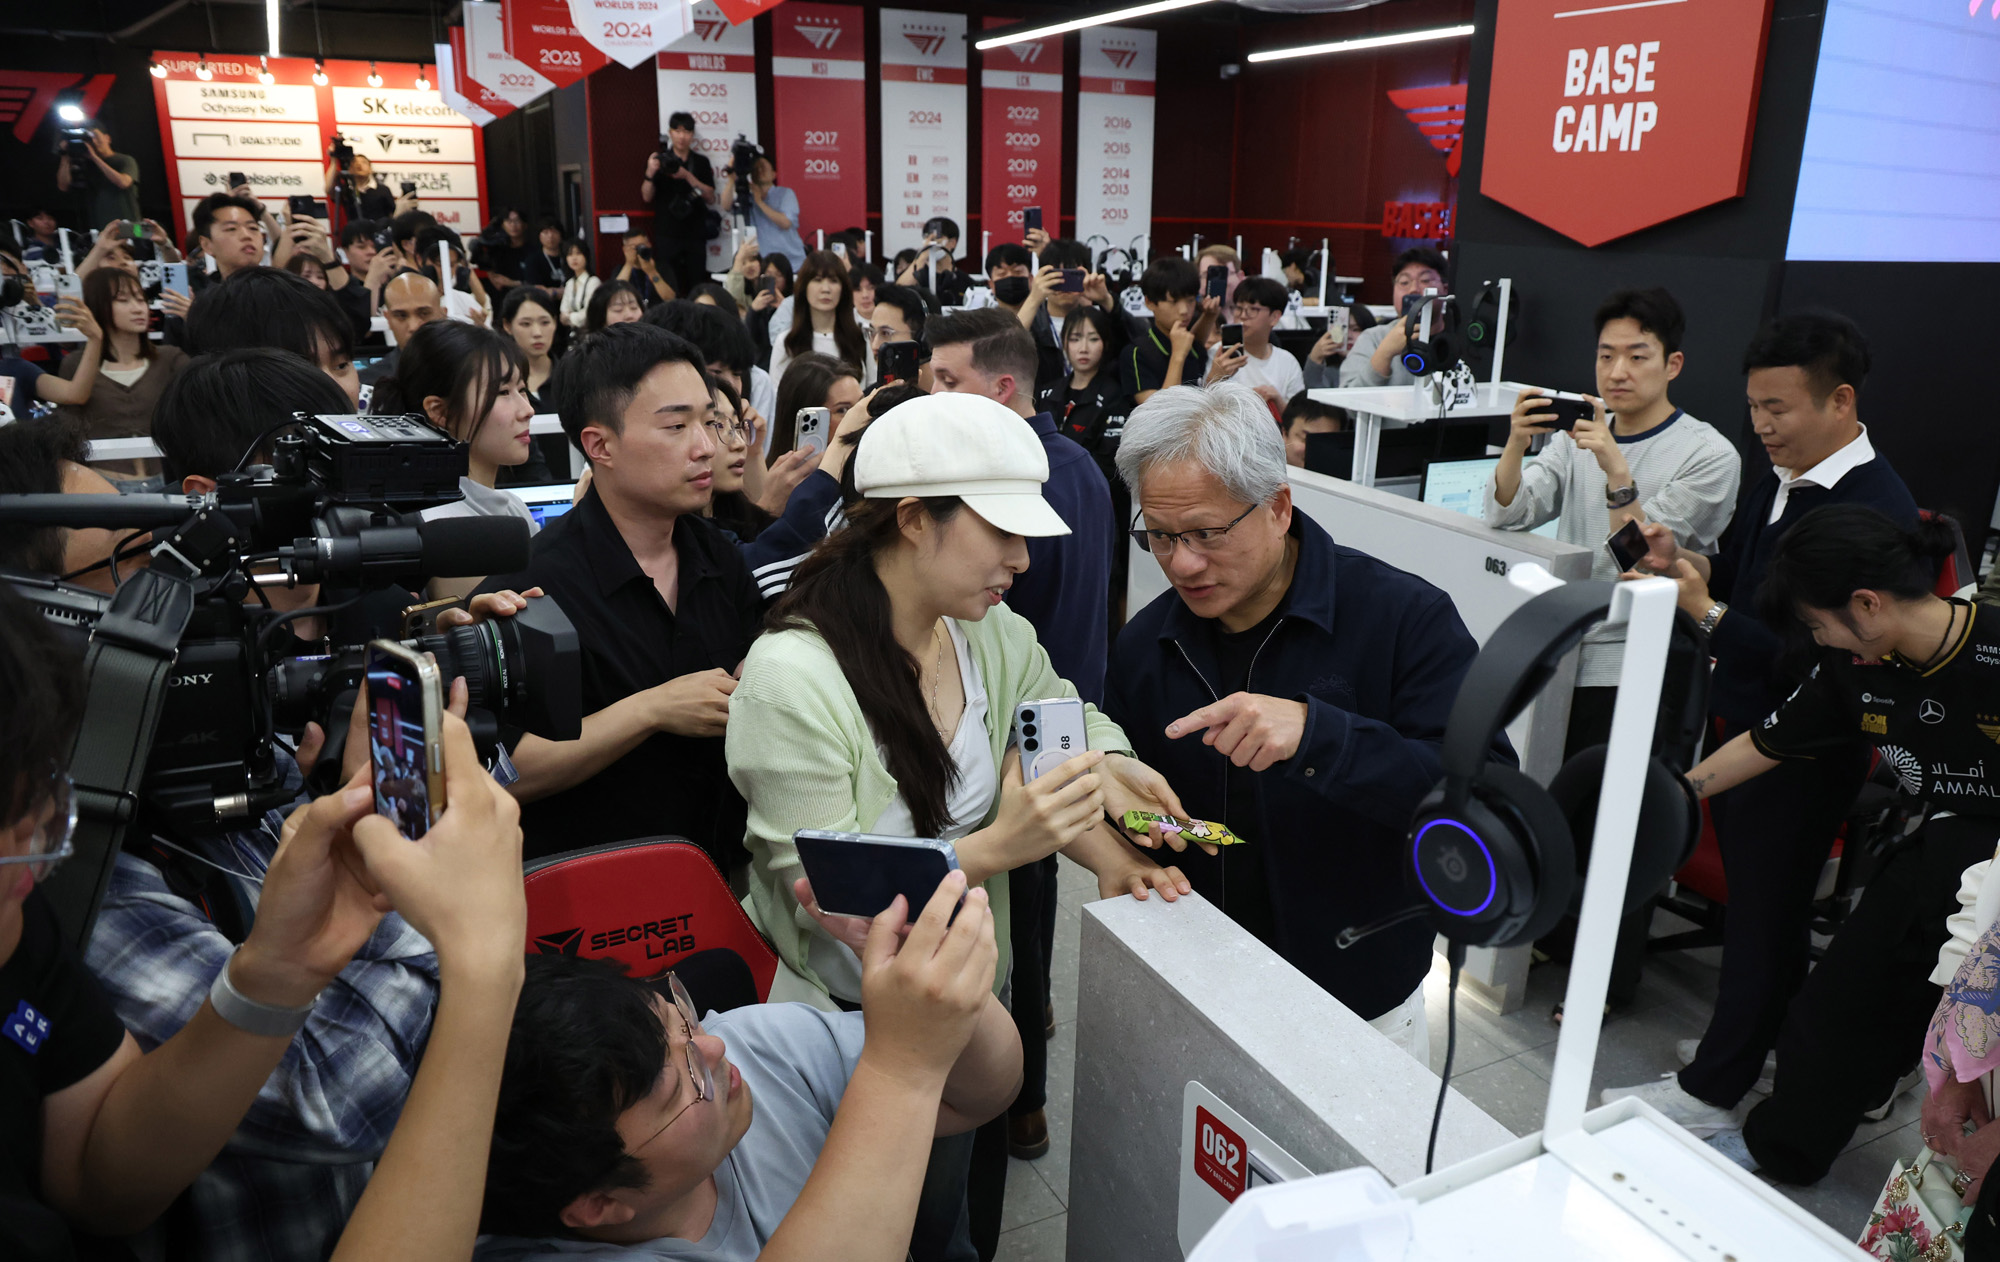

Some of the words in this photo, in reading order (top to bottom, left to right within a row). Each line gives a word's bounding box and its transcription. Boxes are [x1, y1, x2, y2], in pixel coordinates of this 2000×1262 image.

[532, 24, 567, 35] WORLDS
[603, 22, 652, 38] 2024
[539, 49, 582, 66] 2023
[688, 54, 726, 70] WORLDS
[812, 62, 828, 75] MSI
[1563, 40, 1660, 97] BASE
[499, 73, 535, 86] 2022
[201, 87, 266, 99] SAMSUNG
[689, 83, 727, 96] 2025
[1112, 81, 1126, 93] LCK
[202, 103, 256, 117] Odyssey
[260, 105, 285, 115] Neo
[363, 97, 389, 114] SK
[909, 111, 942, 123] 2024
[1007, 106, 1039, 120] 2022
[1104, 116, 1132, 129] 2016
[1552, 101, 1658, 153] CAMP
[240, 136, 302, 146] GOALSTUDIO
[804, 131, 838, 145] 2017
[1005, 132, 1040, 147] 2020
[420, 145, 440, 154] LAB
[1103, 142, 1131, 155] 2015
[804, 160, 839, 174] 2016
[1007, 158, 1037, 172] 2019
[394, 171, 449, 182] TURTLE
[1103, 167, 1130, 179] 2014
[1007, 185, 1037, 198] 2019
[1102, 183, 1130, 196] 2013
[1102, 208, 1129, 220] 2013
[1382, 201, 1446, 239] BASE
[1485, 556, 1507, 576] 063
[1976, 644, 2000, 654] SAM
[1976, 654, 2000, 666] Odys
[168, 673, 213, 688] ONY
[1872, 696, 1896, 706] Spotify
[1862, 712, 1887, 725] GOAL
[1861, 721, 1888, 735] STUDIO
[591, 913, 694, 951] SECRET
[646, 934, 695, 960] LAB
[1202, 1123, 1240, 1178] 062
